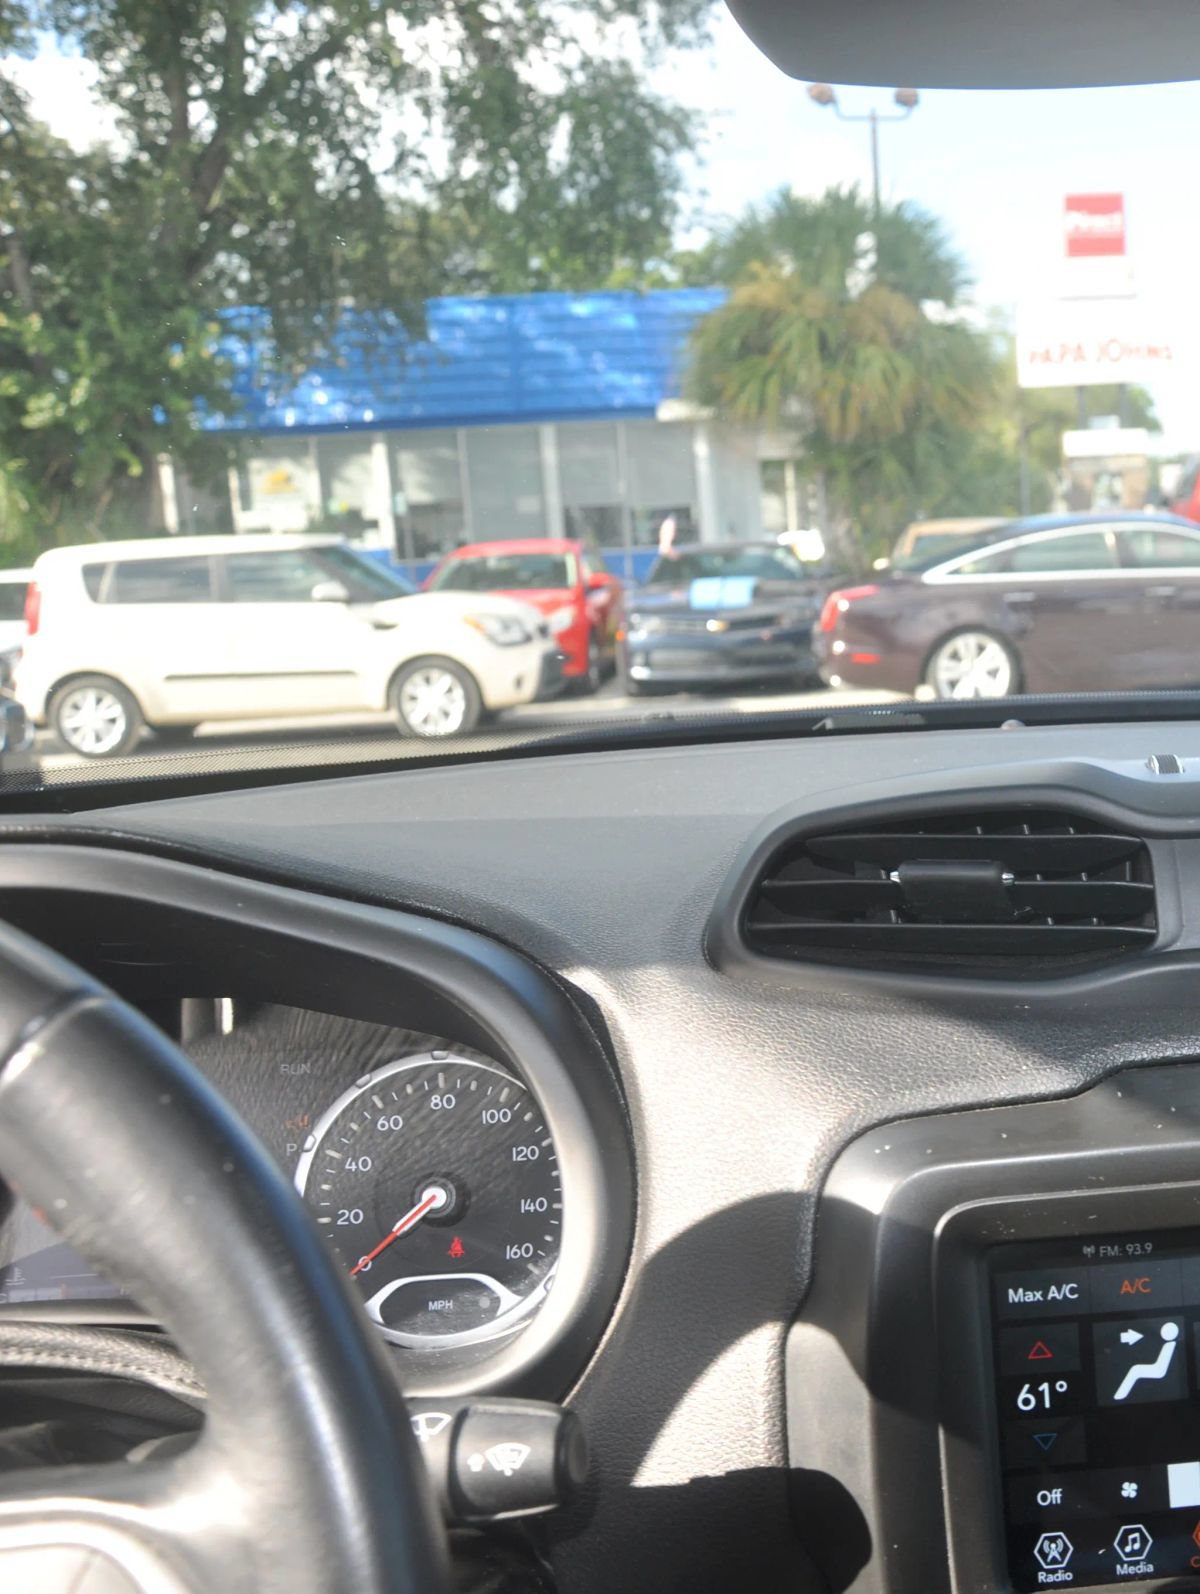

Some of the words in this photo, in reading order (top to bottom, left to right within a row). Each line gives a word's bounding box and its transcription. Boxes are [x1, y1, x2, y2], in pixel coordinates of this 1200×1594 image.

[430, 1093, 456, 1110] 80
[376, 1114, 404, 1131] 60
[482, 1108, 512, 1125] 100
[512, 1144, 540, 1162] 120
[344, 1155, 372, 1172] 40
[520, 1196, 548, 1214] 140
[336, 1208, 364, 1225] 20
[505, 1242, 534, 1260] 160
[1125, 1242, 1153, 1256] 93.9
[1008, 1287, 1044, 1304] Max
[1047, 1283, 1079, 1301] A/C
[1120, 1277, 1151, 1294] A/C
[428, 1299, 454, 1312] MPH
[1016, 1380, 1068, 1411] 61°
[1036, 1488, 1063, 1507] Off
[1037, 1570, 1074, 1584] Radio
[1115, 1562, 1154, 1576] Media
